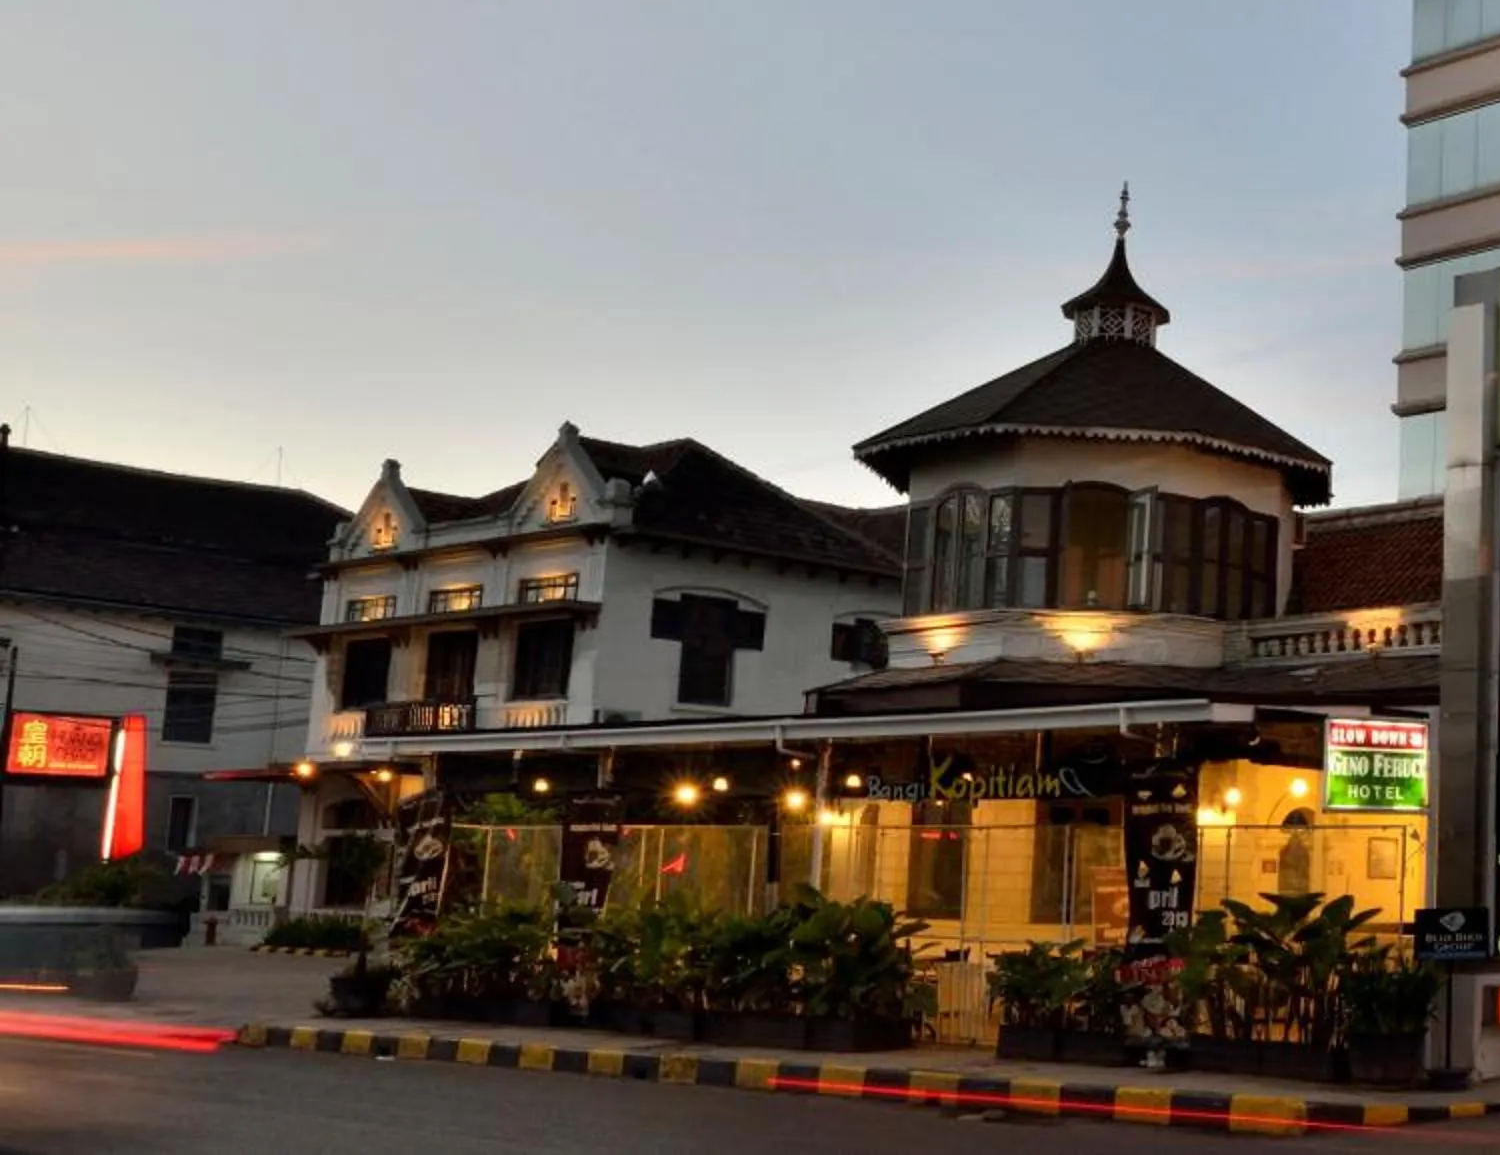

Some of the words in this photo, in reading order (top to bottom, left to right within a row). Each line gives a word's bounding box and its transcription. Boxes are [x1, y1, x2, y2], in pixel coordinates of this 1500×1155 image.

[1331, 728, 1367, 744] SLOW
[1329, 752, 1370, 777] GINO
[867, 775, 926, 802] Bangi
[928, 749, 1062, 800] Kopitiam
[1347, 785, 1404, 801] HOTEL
